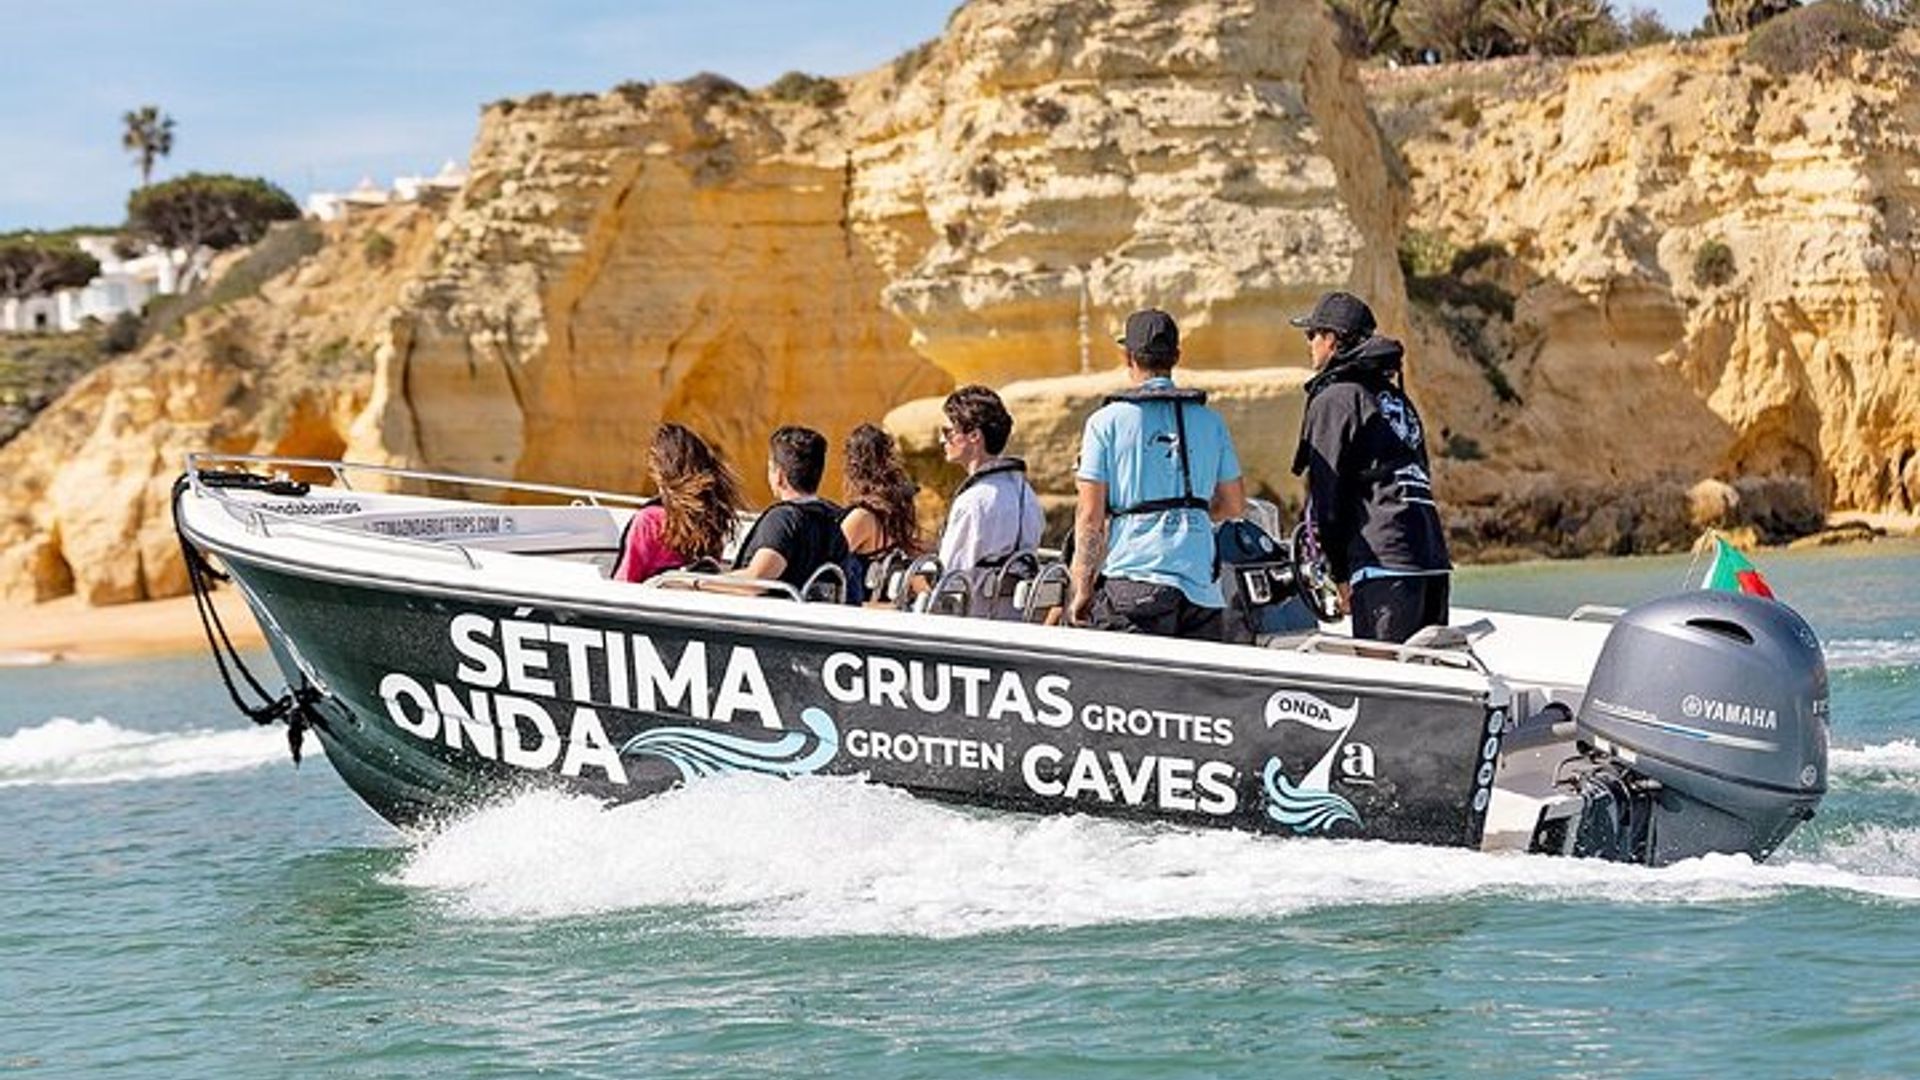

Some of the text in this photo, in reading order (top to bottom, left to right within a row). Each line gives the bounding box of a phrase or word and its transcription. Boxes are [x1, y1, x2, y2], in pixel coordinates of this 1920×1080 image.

[450, 606, 783, 730] SÉTIMA
[822, 651, 1074, 728] GRUTAS
[378, 672, 629, 785] ONDA
[1080, 703, 1235, 746] GROTTES
[1277, 697, 1333, 723] ONDA
[1702, 700, 1778, 730] YAMAHA
[845, 728, 1005, 772] GROTTEN
[1021, 744, 1239, 816] CAVES
